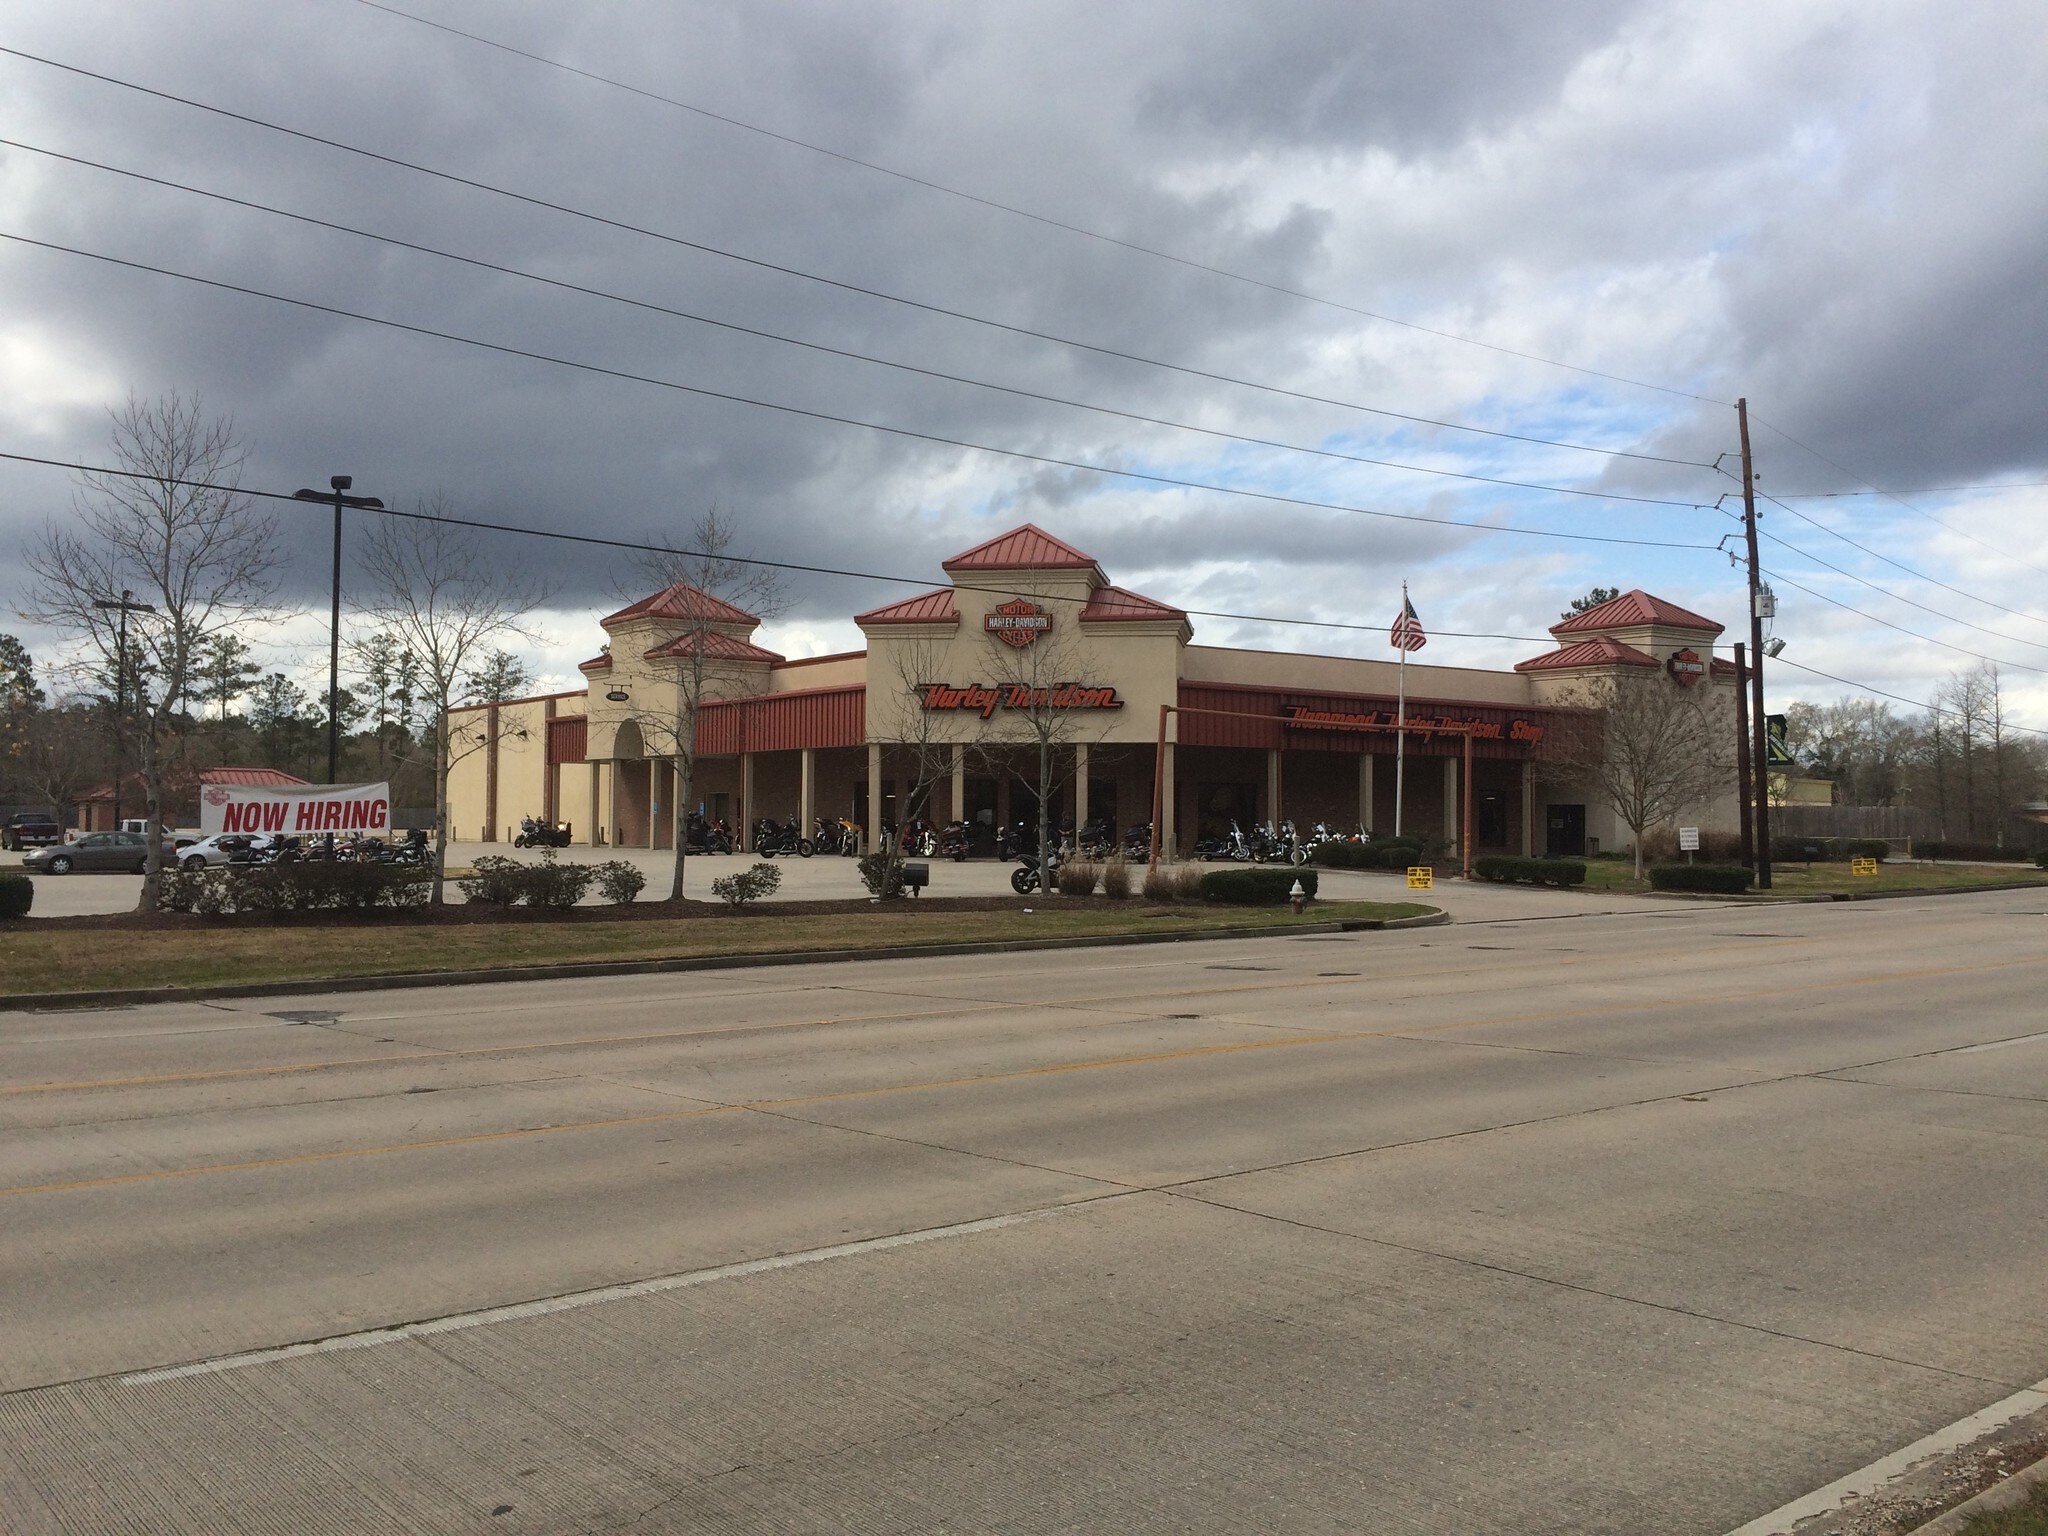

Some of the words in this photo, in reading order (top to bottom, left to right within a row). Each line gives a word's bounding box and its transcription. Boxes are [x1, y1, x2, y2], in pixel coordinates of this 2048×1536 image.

[1003, 605, 1034, 614] MOTOR
[989, 617, 1047, 628] HARLEY-DAVIDSON
[1003, 630, 1033, 641] CYCLES
[1286, 706, 1381, 733] Hammond
[1511, 720, 1544, 749] Shop
[222, 802, 290, 833] NOW
[295, 799, 388, 831] HIRING
